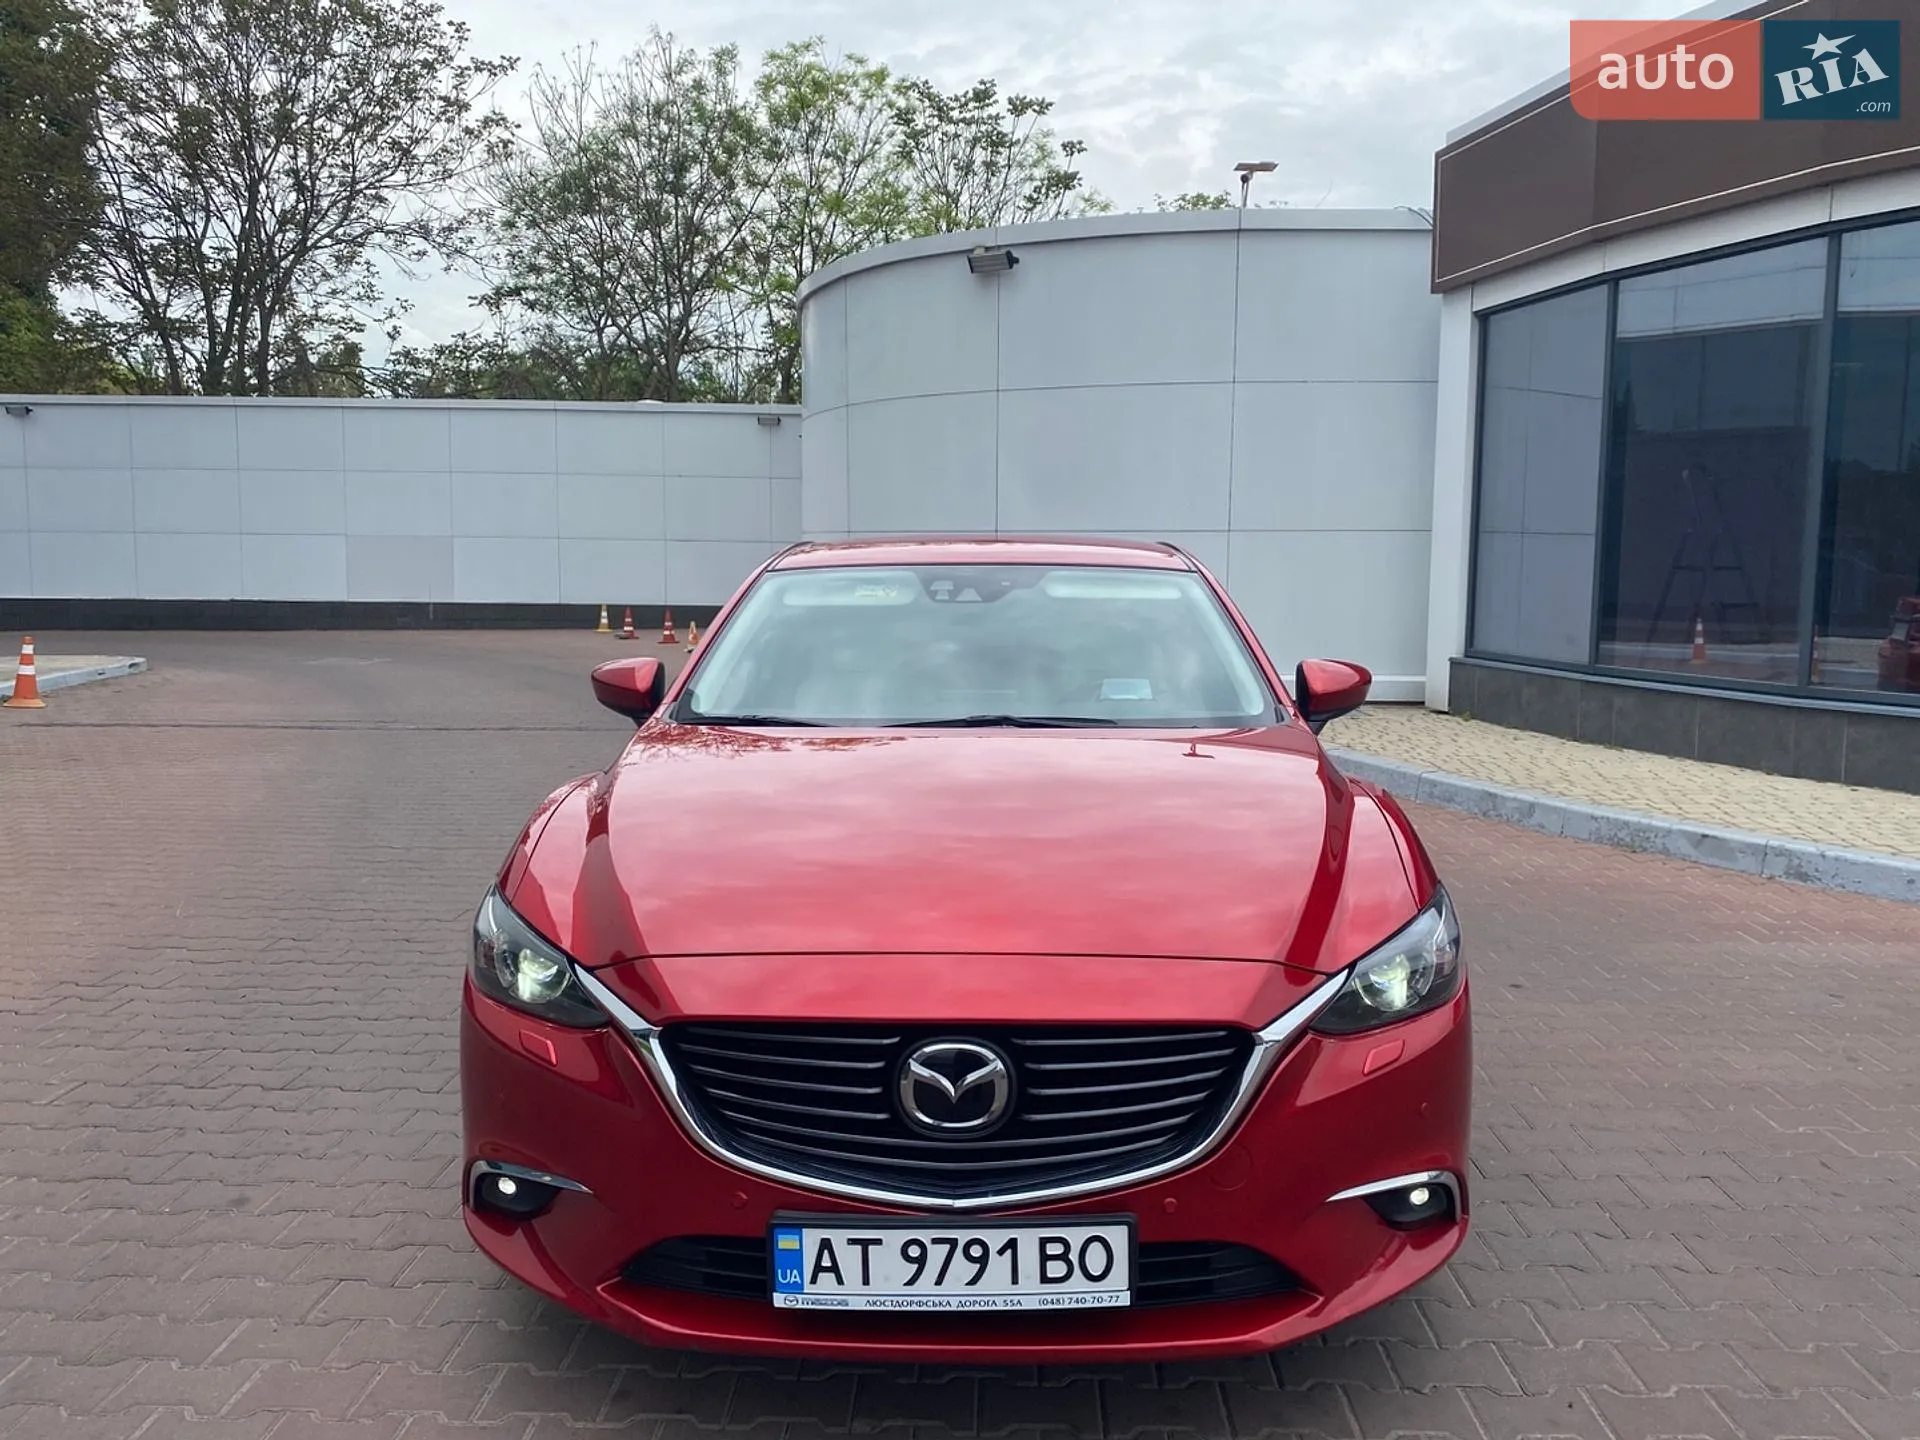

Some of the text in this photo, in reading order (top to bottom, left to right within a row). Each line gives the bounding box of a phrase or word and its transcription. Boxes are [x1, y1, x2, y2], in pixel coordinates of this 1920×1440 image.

[808, 1234, 1115, 1287] AT 9791 BO
[777, 1269, 801, 1285] UA
[955, 1299, 998, 1309] ДОРОГА
[1038, 1297, 1065, 1307] (048)
[1066, 1294, 1121, 1306] 740-70-77
